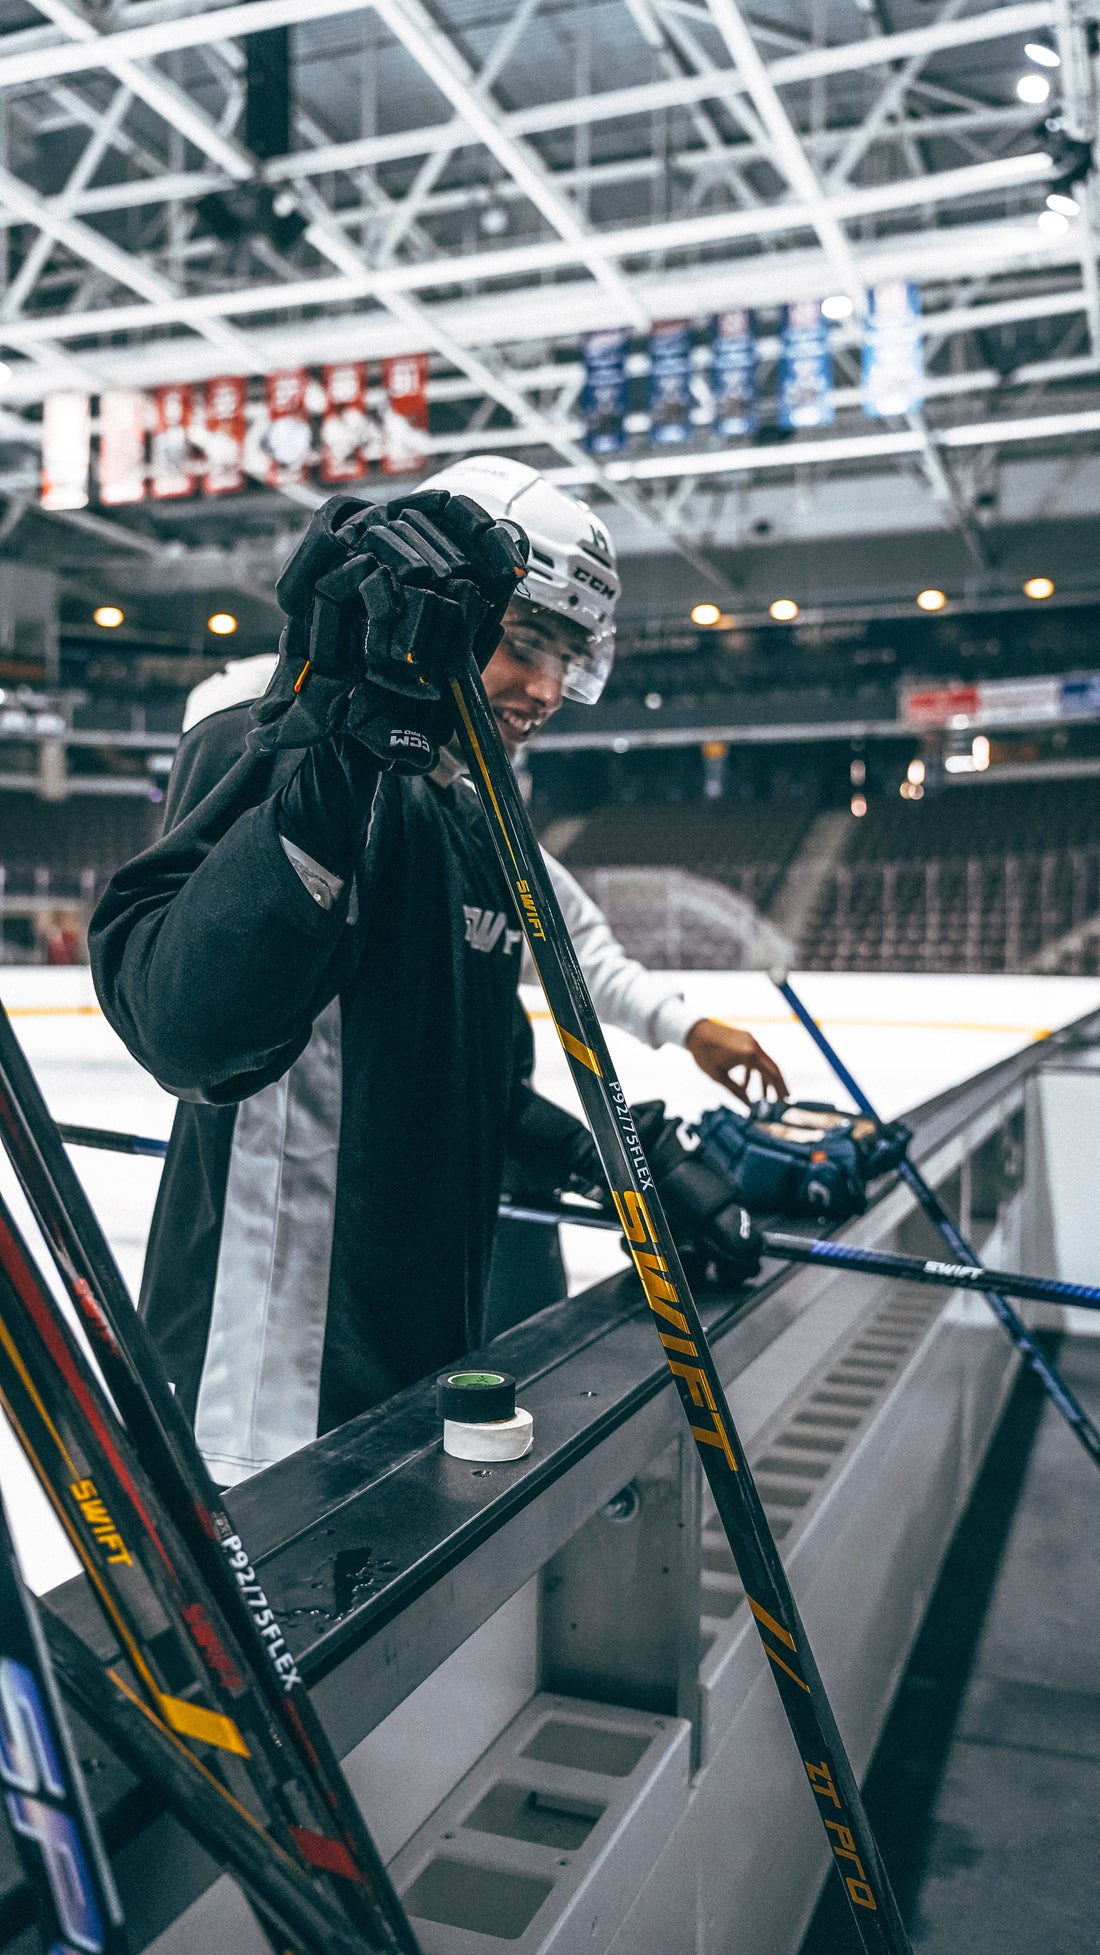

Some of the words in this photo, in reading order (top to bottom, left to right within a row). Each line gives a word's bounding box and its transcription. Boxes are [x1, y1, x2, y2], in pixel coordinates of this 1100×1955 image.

[573, 566, 616, 600] CCM
[389, 735, 431, 753] CCM
[515, 879, 547, 942] SWIFT
[608, 1080, 654, 1191] P92/75FLEX
[923, 1260, 985, 1281] SWIFT
[611, 1190, 738, 1472] SWIFT
[69, 1479, 134, 1567] SWIFT
[220, 1534, 303, 1693] P92/75FLEX
